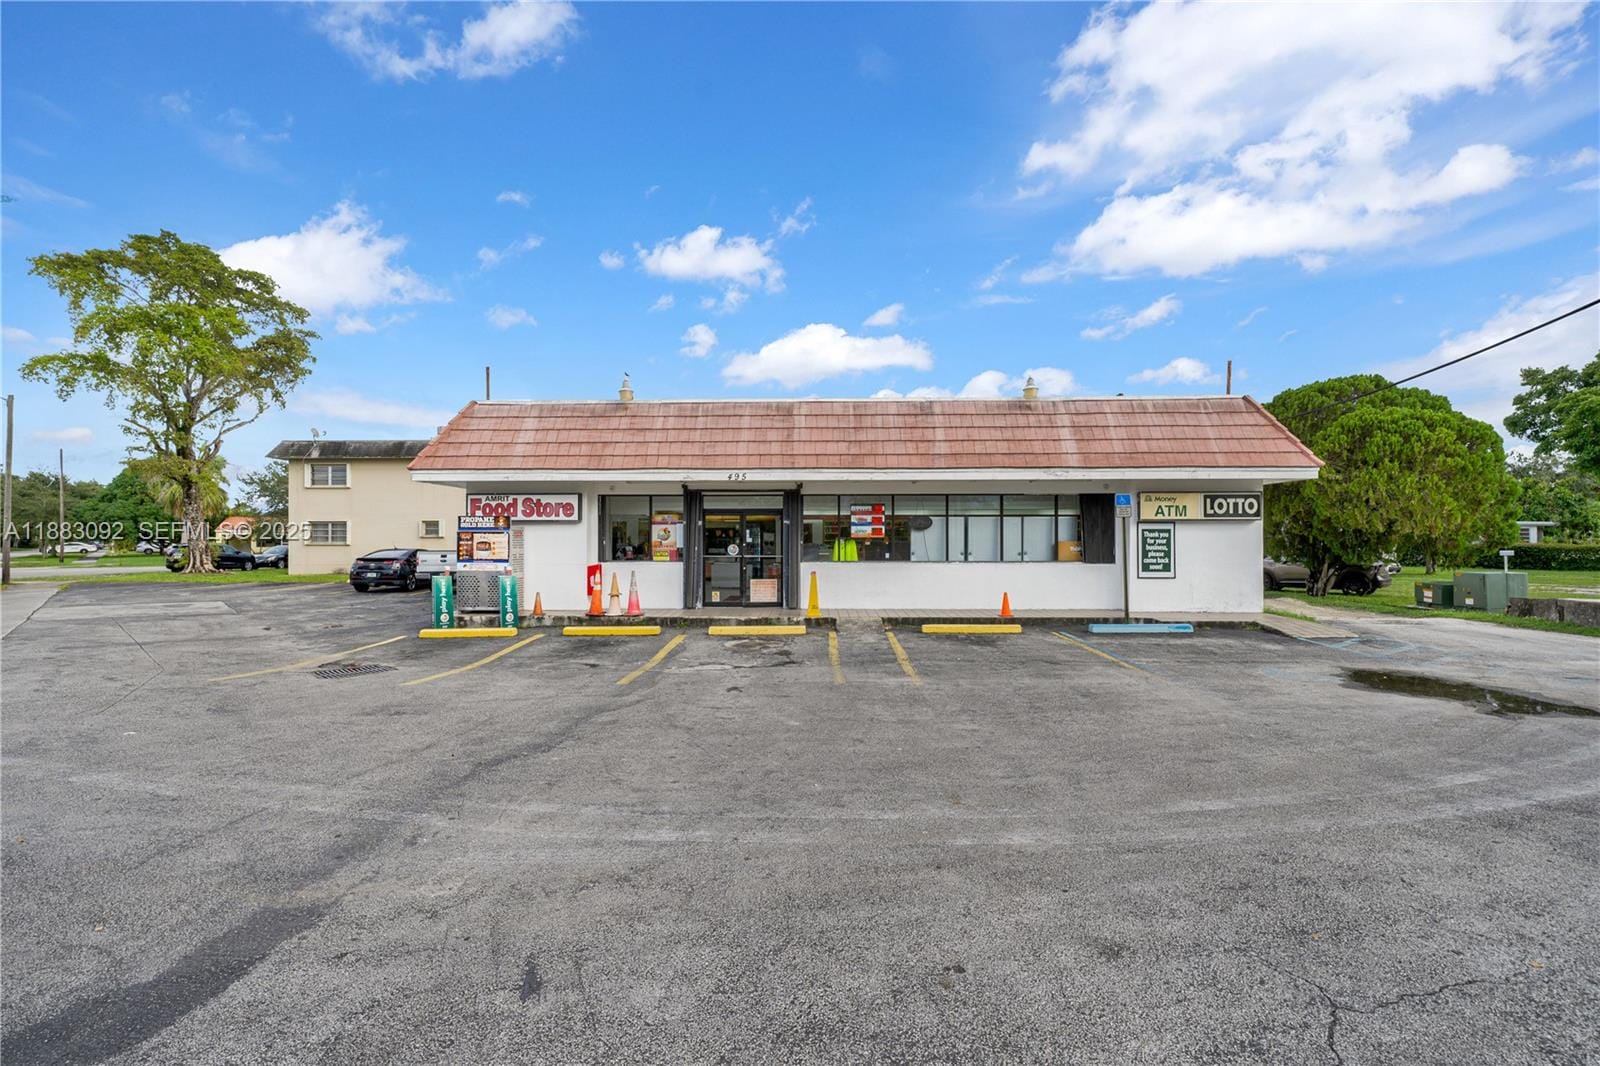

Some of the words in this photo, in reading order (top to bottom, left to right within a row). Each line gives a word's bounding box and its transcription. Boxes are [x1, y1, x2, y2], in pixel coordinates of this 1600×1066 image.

[470, 498, 518, 518] Food
[521, 497, 575, 518] Store
[1155, 505, 1187, 517] ATM
[1206, 498, 1258, 515] LOTTO
[440, 597, 448, 612] play
